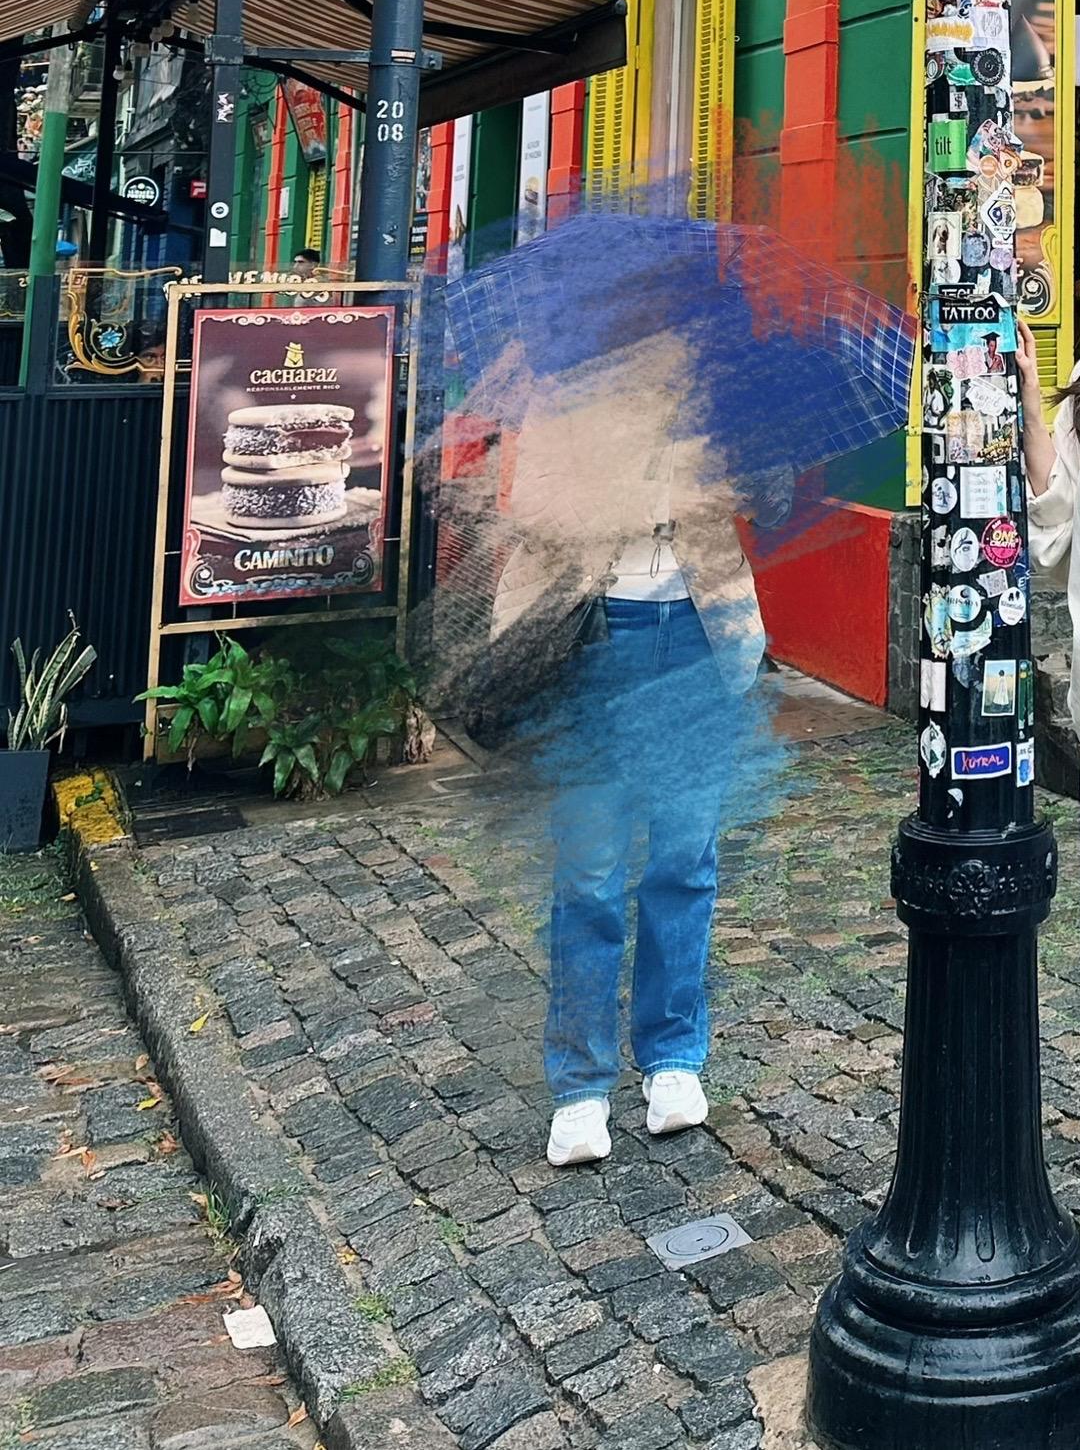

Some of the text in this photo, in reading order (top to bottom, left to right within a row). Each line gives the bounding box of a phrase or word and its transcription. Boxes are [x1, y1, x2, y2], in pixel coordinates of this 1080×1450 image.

[376, 100, 404, 118] 20
[377, 124, 404, 142] 08
[935, 136, 952, 156] tilt
[942, 307, 996, 321] TATTOO
[234, 545, 336, 572] CAMINITO
